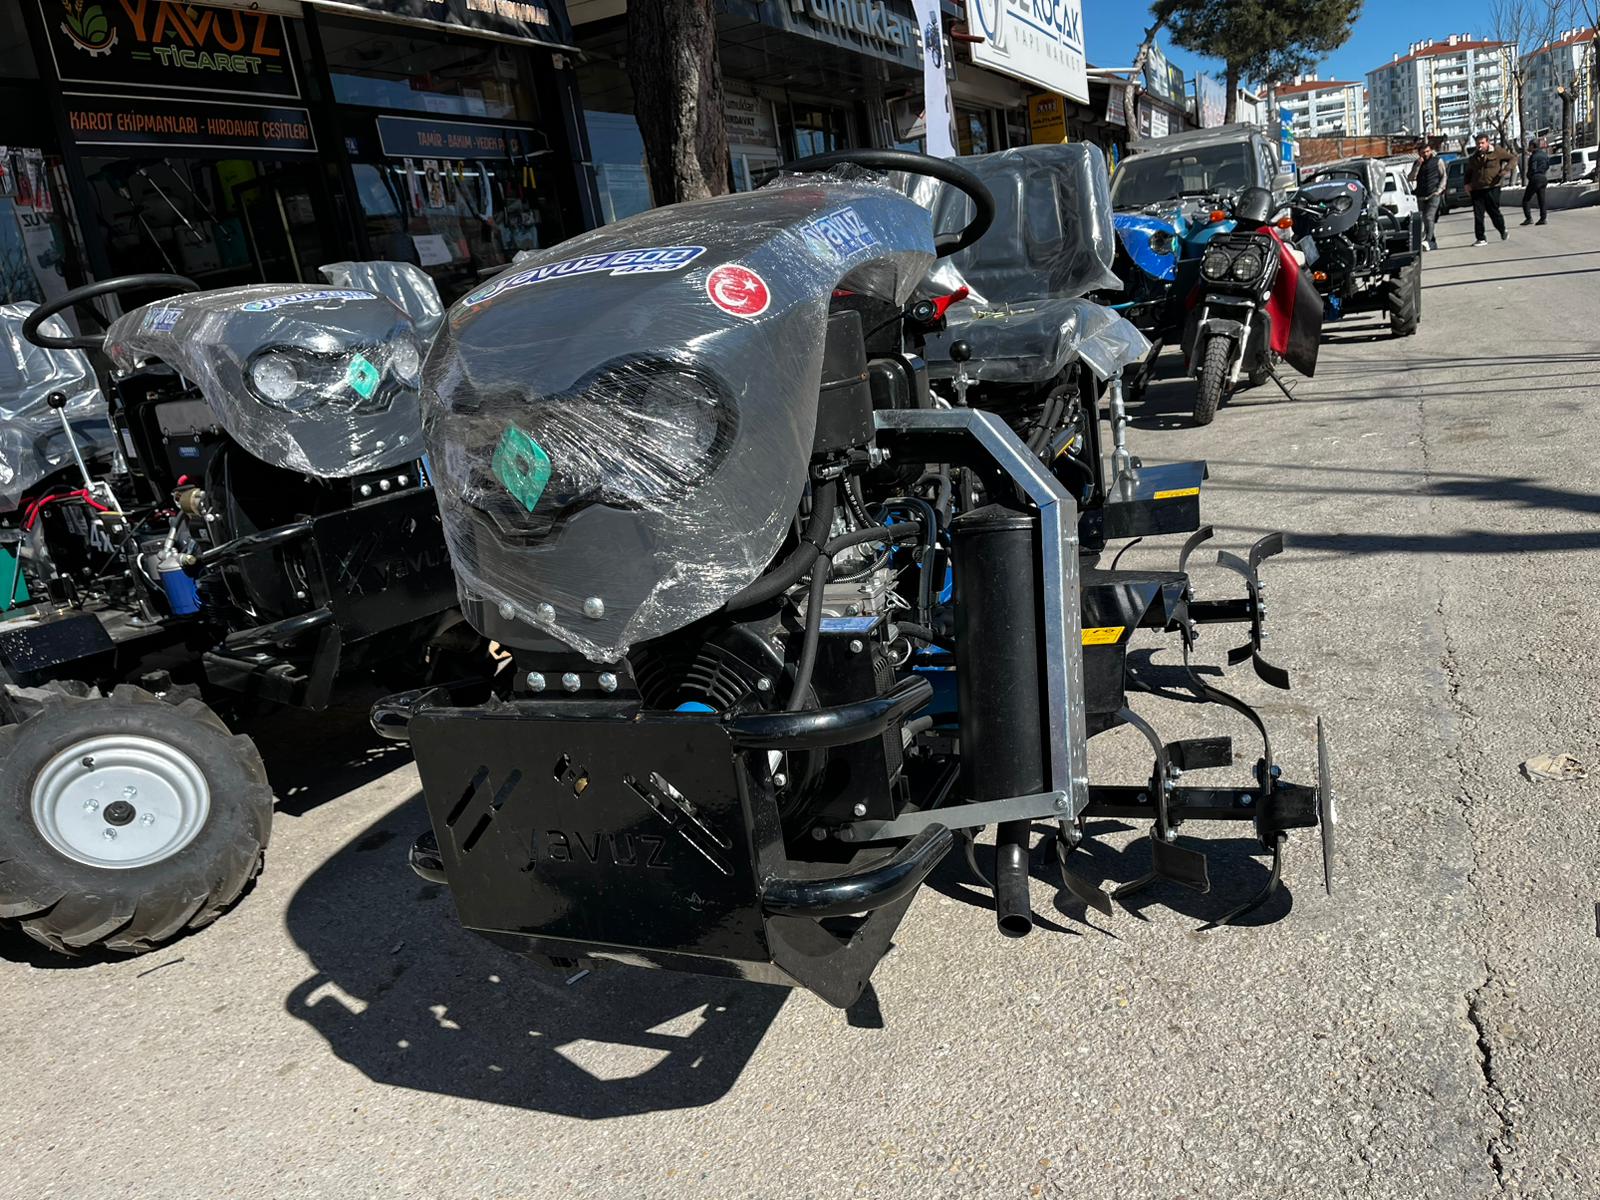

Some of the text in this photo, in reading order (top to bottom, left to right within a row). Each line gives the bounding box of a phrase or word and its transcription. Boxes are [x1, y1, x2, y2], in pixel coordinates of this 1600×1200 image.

[119, 0, 280, 56] YAVUZ
[791, 0, 912, 48] umuklar
[153, 45, 262, 74] TİCARET
[69, 111, 113, 131] KAROT
[116, 110, 198, 134] EKİPMANLARI
[207, 118, 260, 138] HIRDAVAT
[488, 249, 688, 295] yavuz 600
